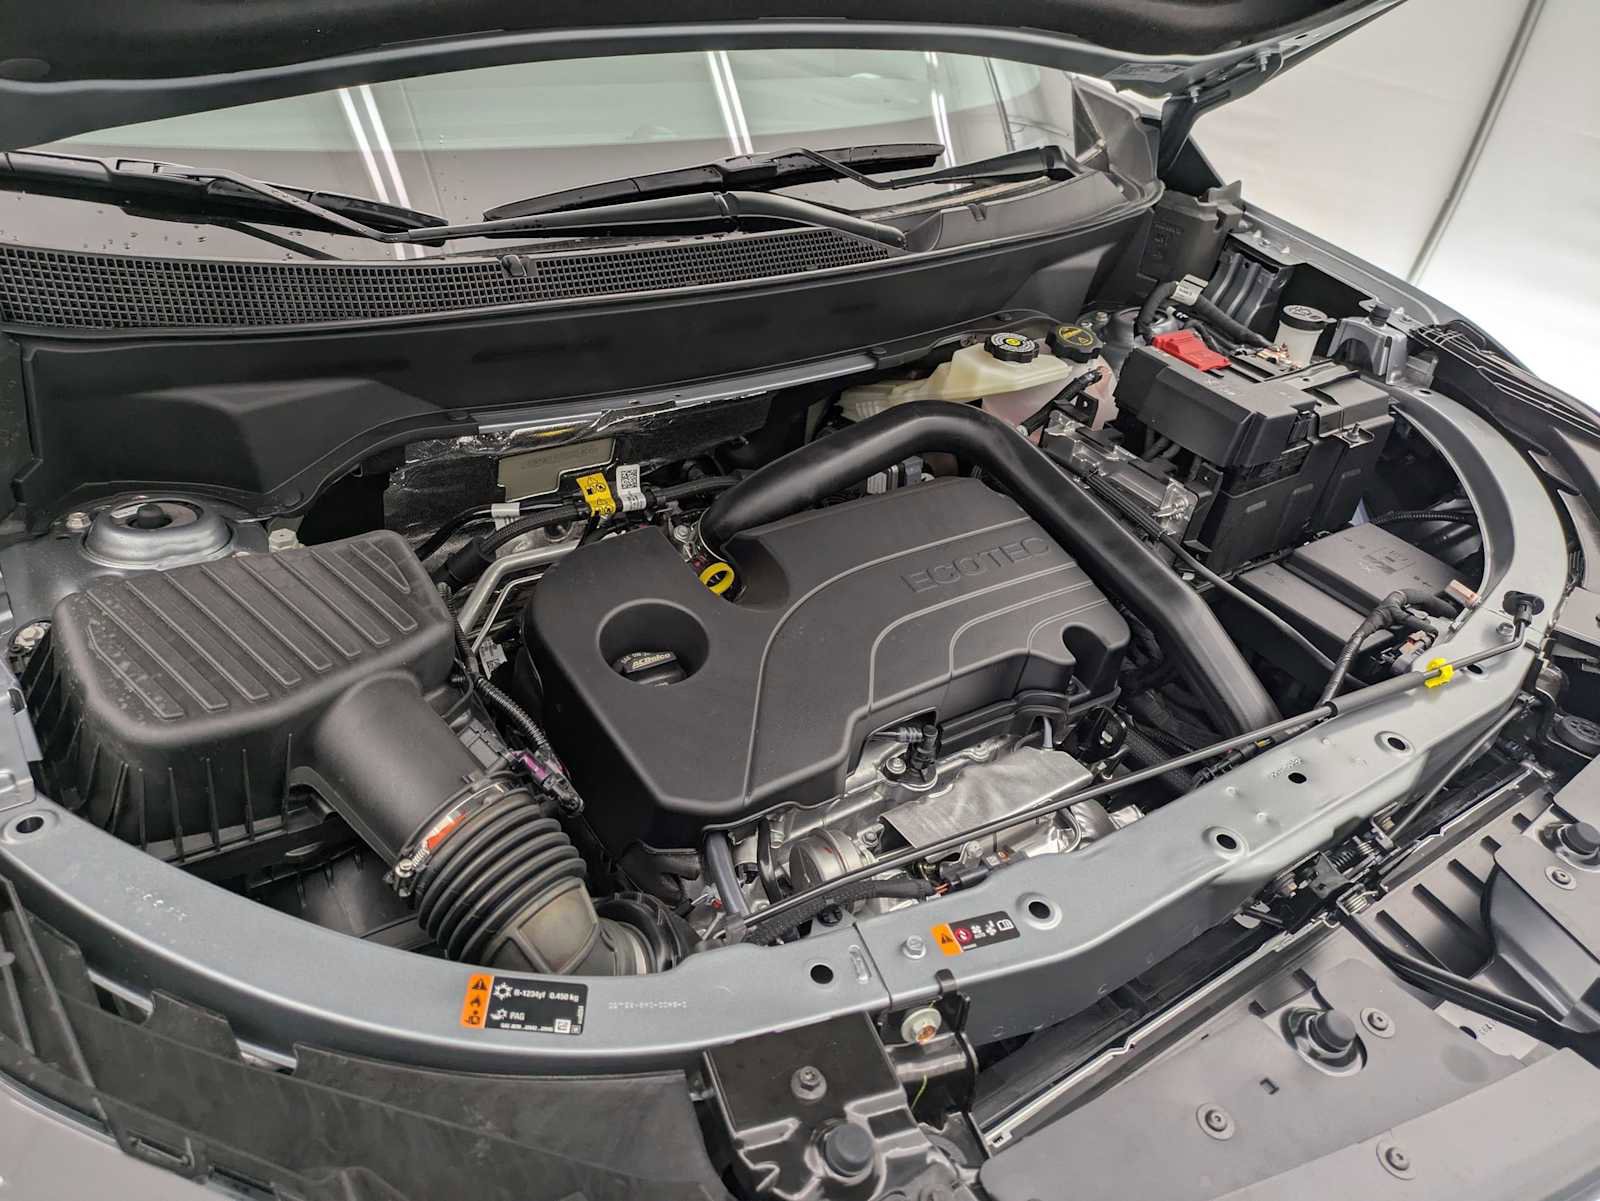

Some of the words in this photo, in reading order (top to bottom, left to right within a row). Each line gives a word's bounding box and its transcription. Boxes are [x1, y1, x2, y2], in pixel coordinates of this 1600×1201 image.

[900, 537, 1050, 593] ECOTEC
[570, 992, 579, 1003] kg
[509, 1011, 525, 1021] PAG
